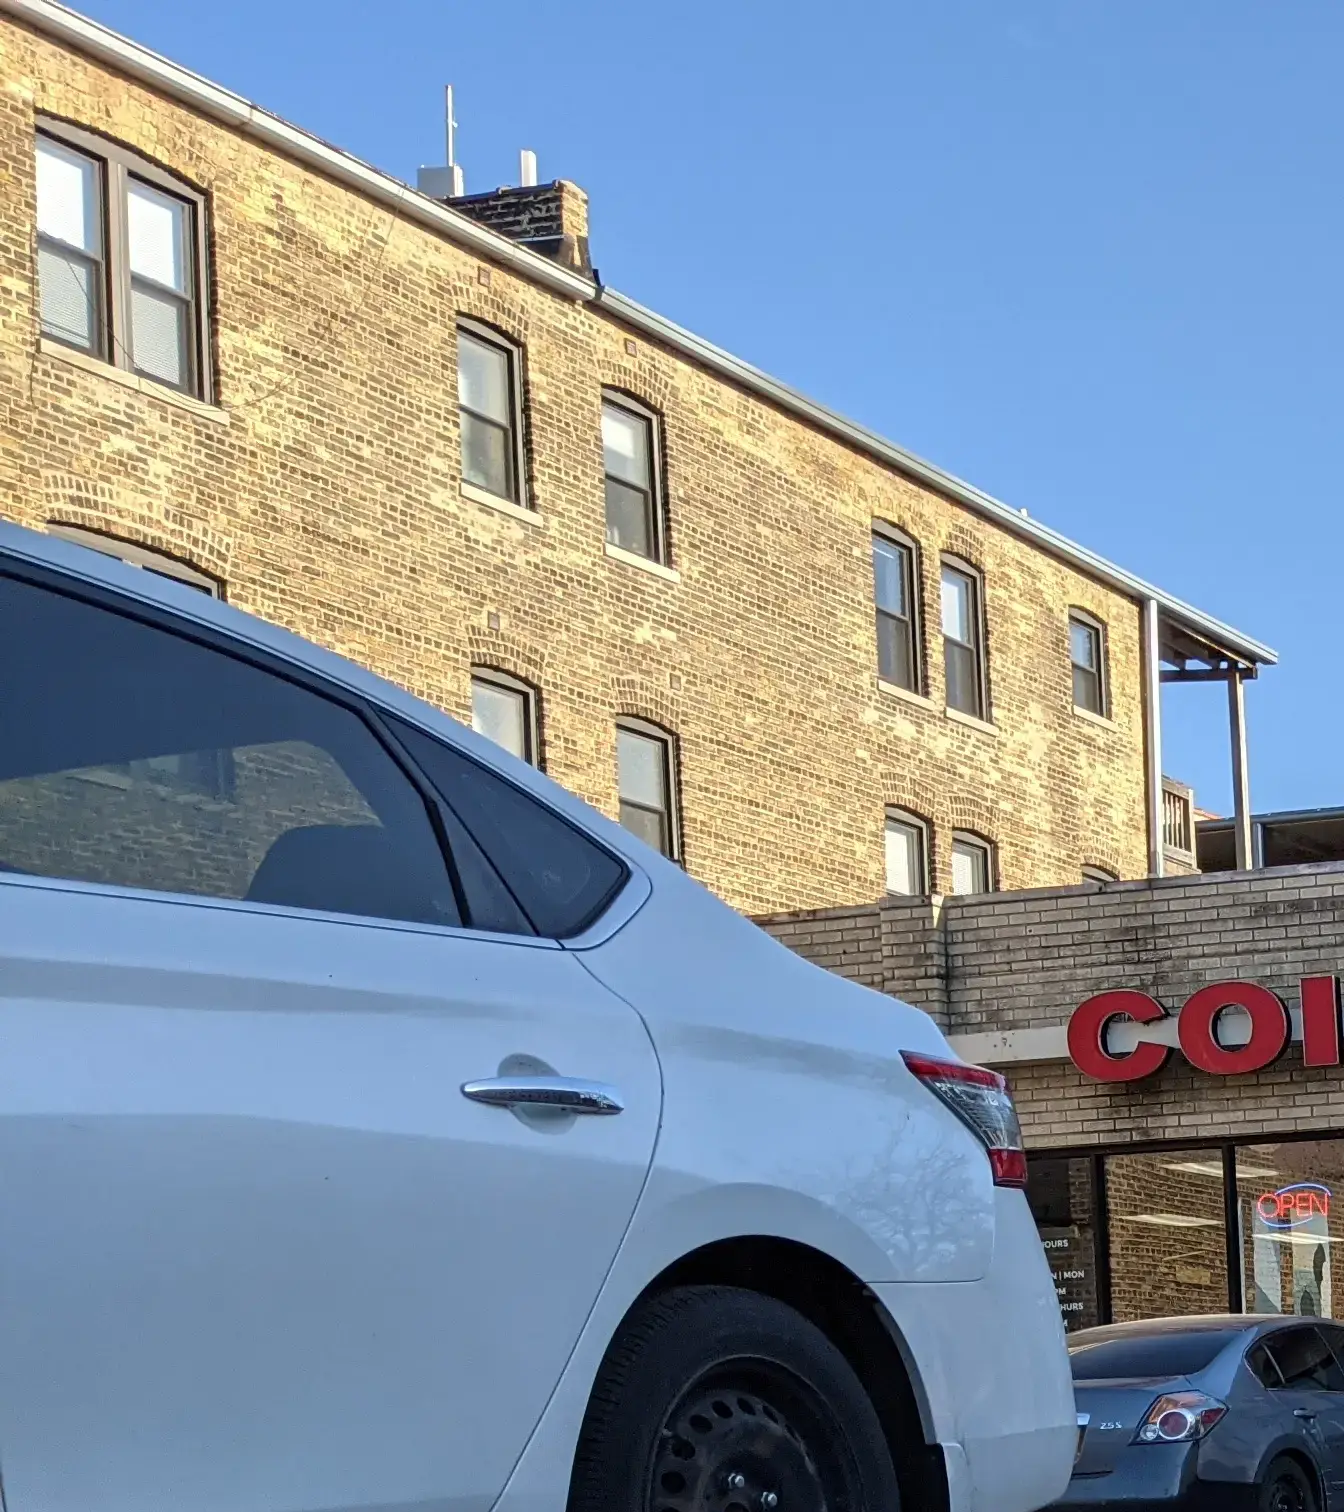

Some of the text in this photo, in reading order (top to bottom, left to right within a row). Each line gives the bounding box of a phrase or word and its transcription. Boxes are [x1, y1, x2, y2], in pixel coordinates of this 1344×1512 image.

[1257, 1192, 1329, 1218] OPEN
[1042, 1239, 1069, 1249] OURS
[1063, 1270, 1085, 1279] MON
[1060, 1302, 1084, 1311] HURS
